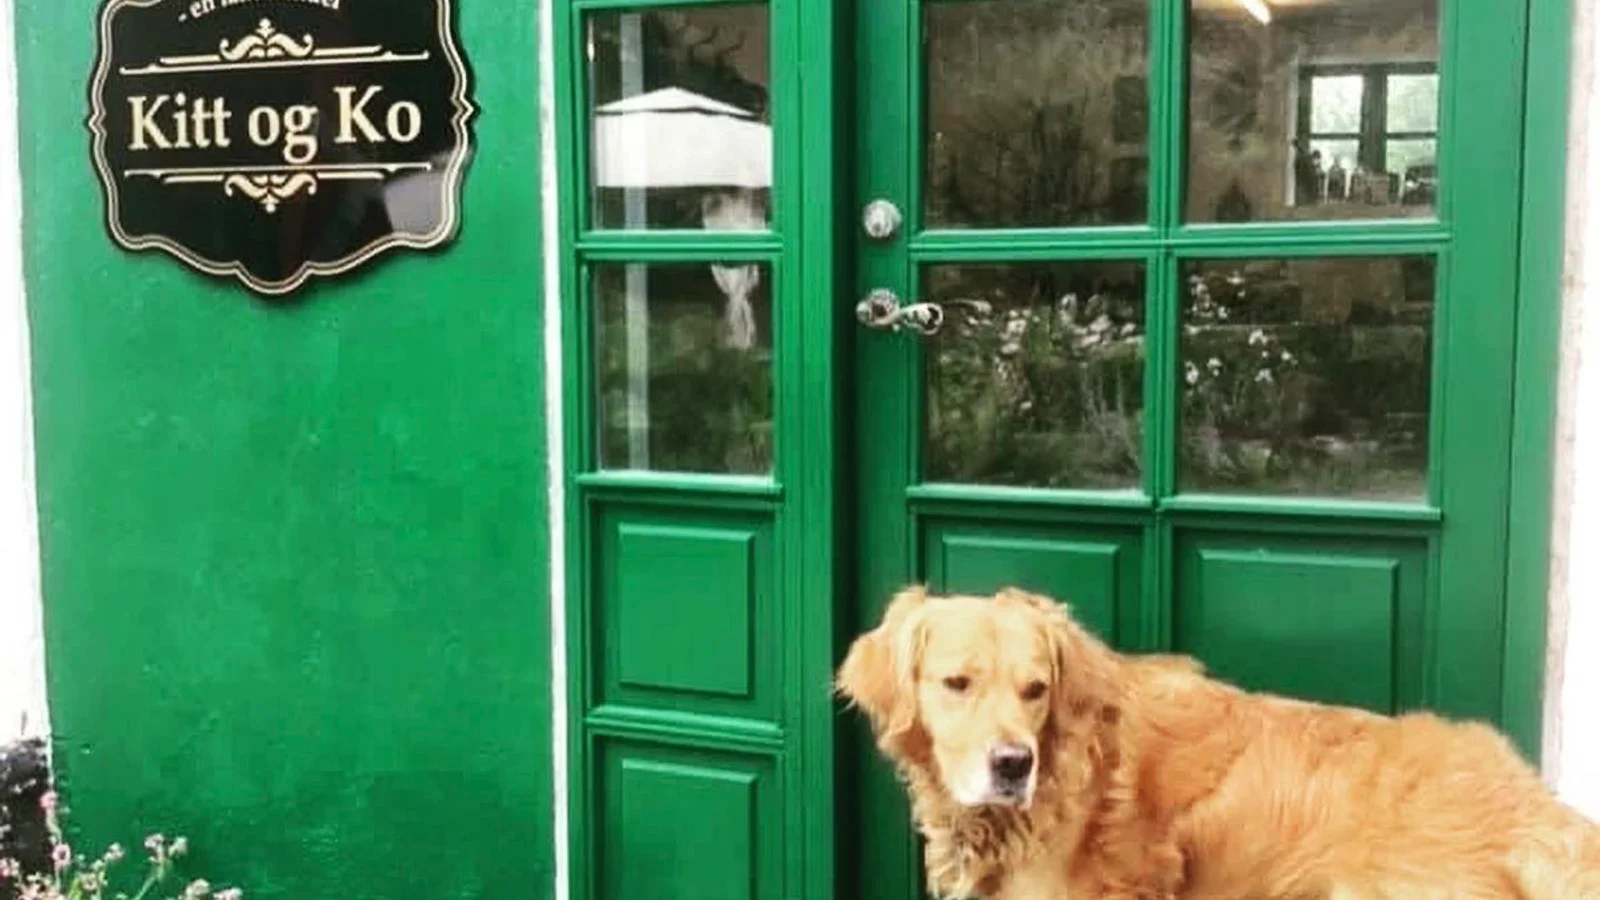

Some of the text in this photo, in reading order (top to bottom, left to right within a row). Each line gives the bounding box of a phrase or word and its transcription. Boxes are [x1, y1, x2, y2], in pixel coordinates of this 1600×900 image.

[127, 85, 422, 164] Kitt og Ko
